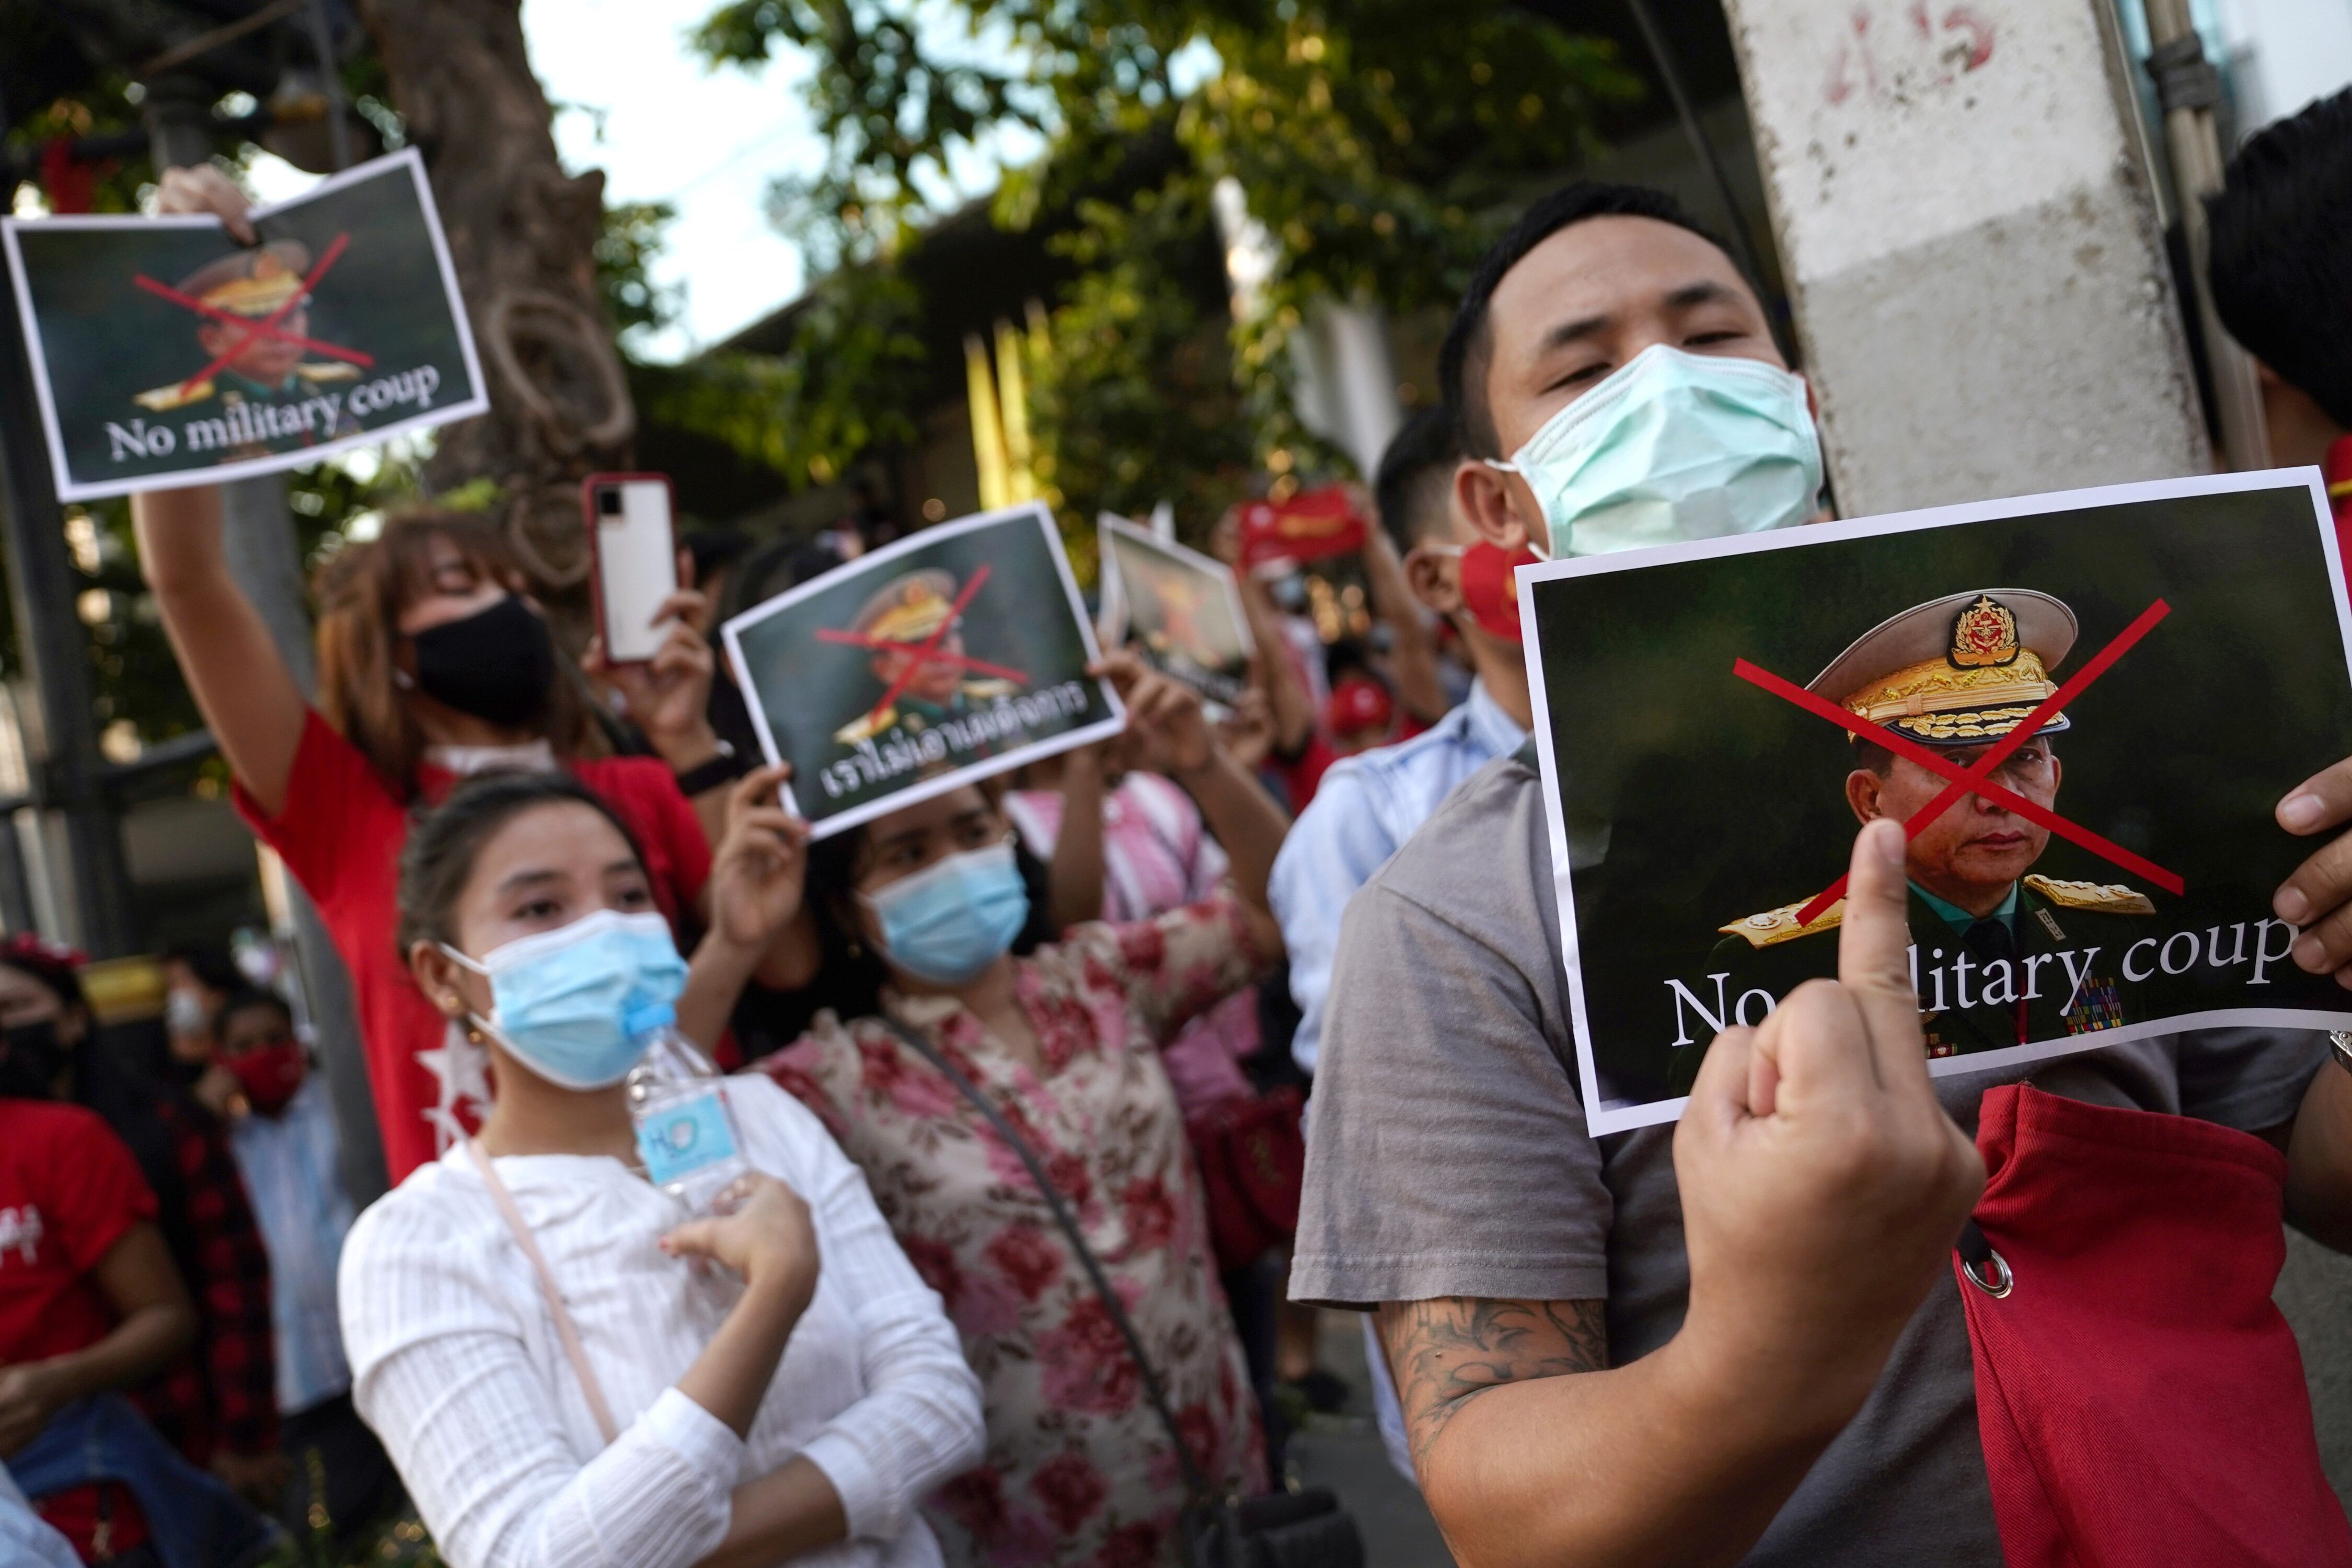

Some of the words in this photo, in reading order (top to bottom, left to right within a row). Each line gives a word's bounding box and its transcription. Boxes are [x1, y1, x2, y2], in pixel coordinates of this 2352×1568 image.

[106, 418, 177, 462] No
[185, 393, 341, 452] military
[348, 364, 441, 417] coup
[1664, 972, 1777, 1046] No
[1906, 943, 2102, 1017] litary
[2122, 918, 2299, 984] coup
